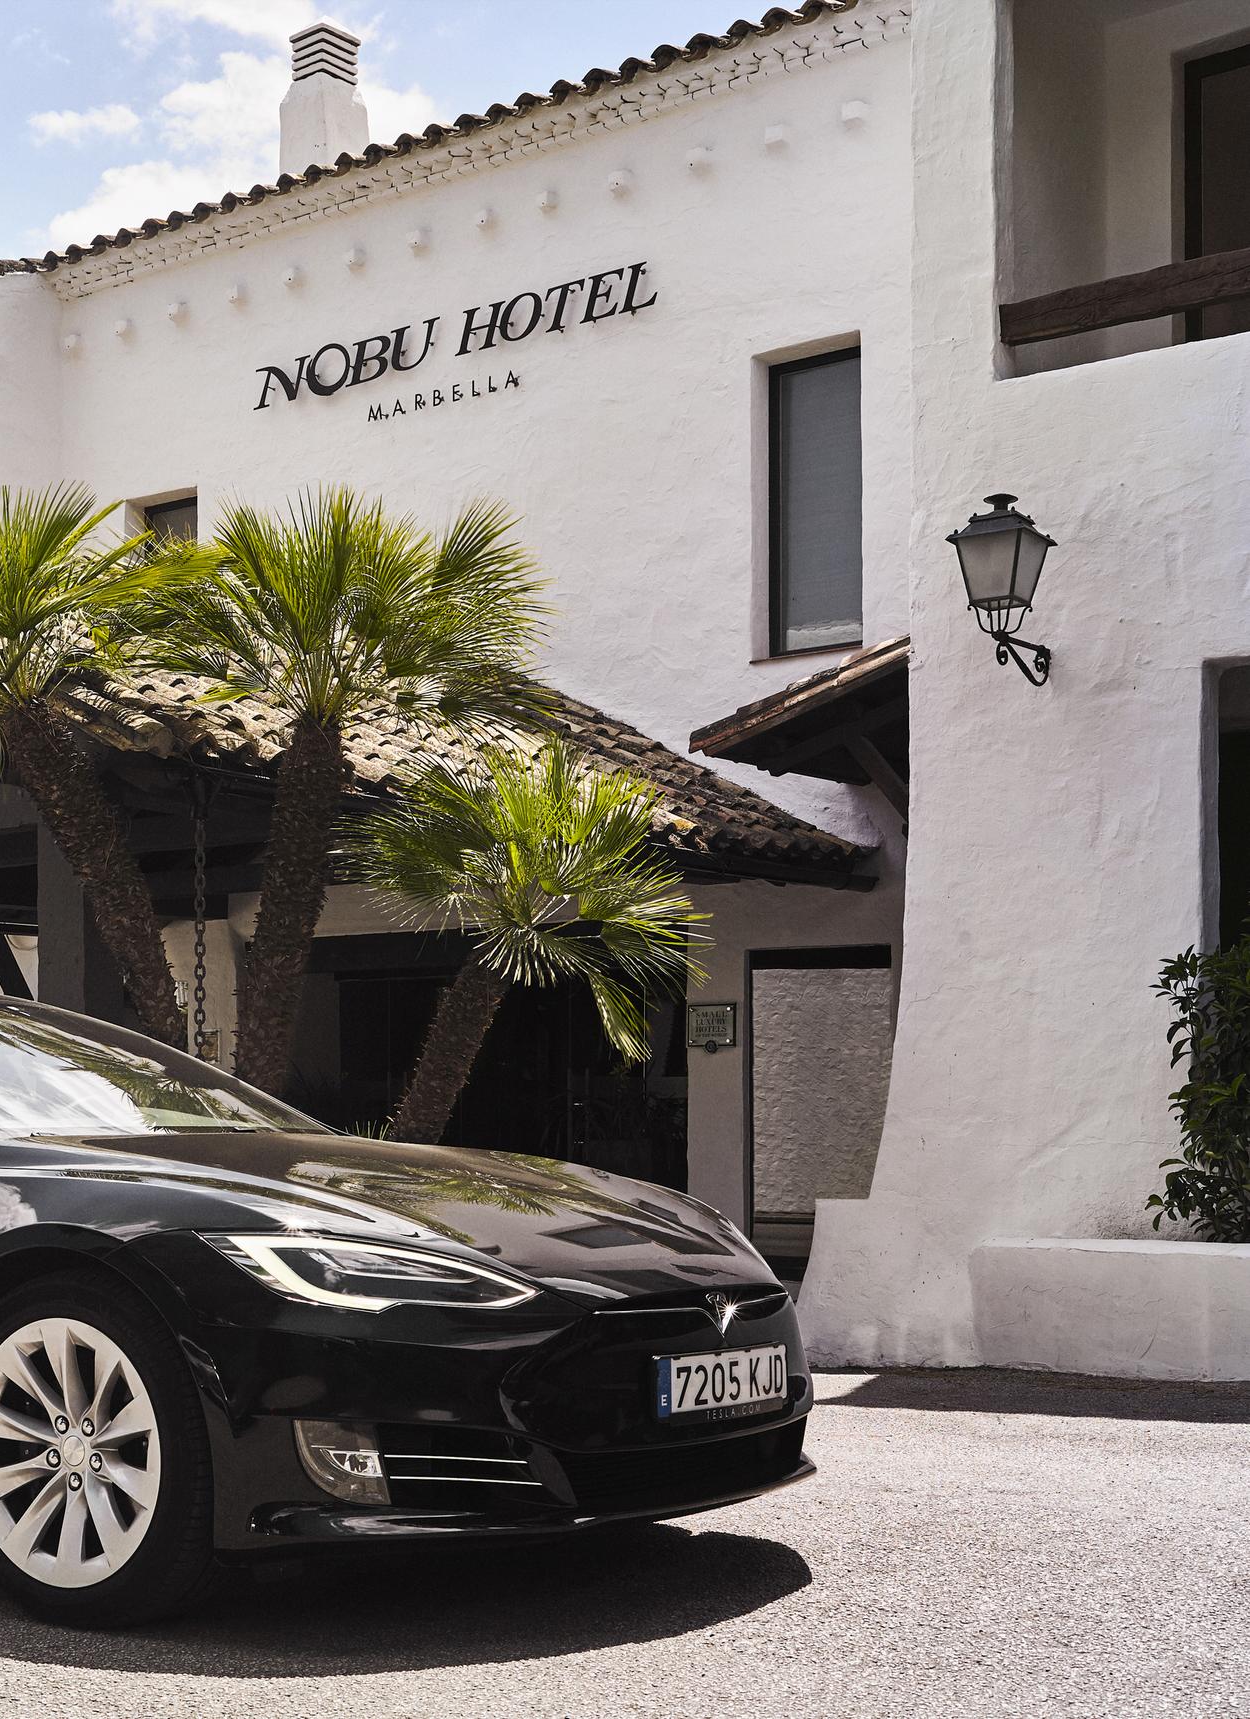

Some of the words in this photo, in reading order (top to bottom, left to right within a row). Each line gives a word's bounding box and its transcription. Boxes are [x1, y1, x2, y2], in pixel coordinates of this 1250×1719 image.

[253, 316, 441, 411] NOBU
[455, 261, 659, 357] HOTEL
[367, 370, 519, 423] MARBELLA
[661, 1394, 668, 1407] E
[676, 1360, 741, 1409] 7205
[750, 1355, 784, 1398] KJD
